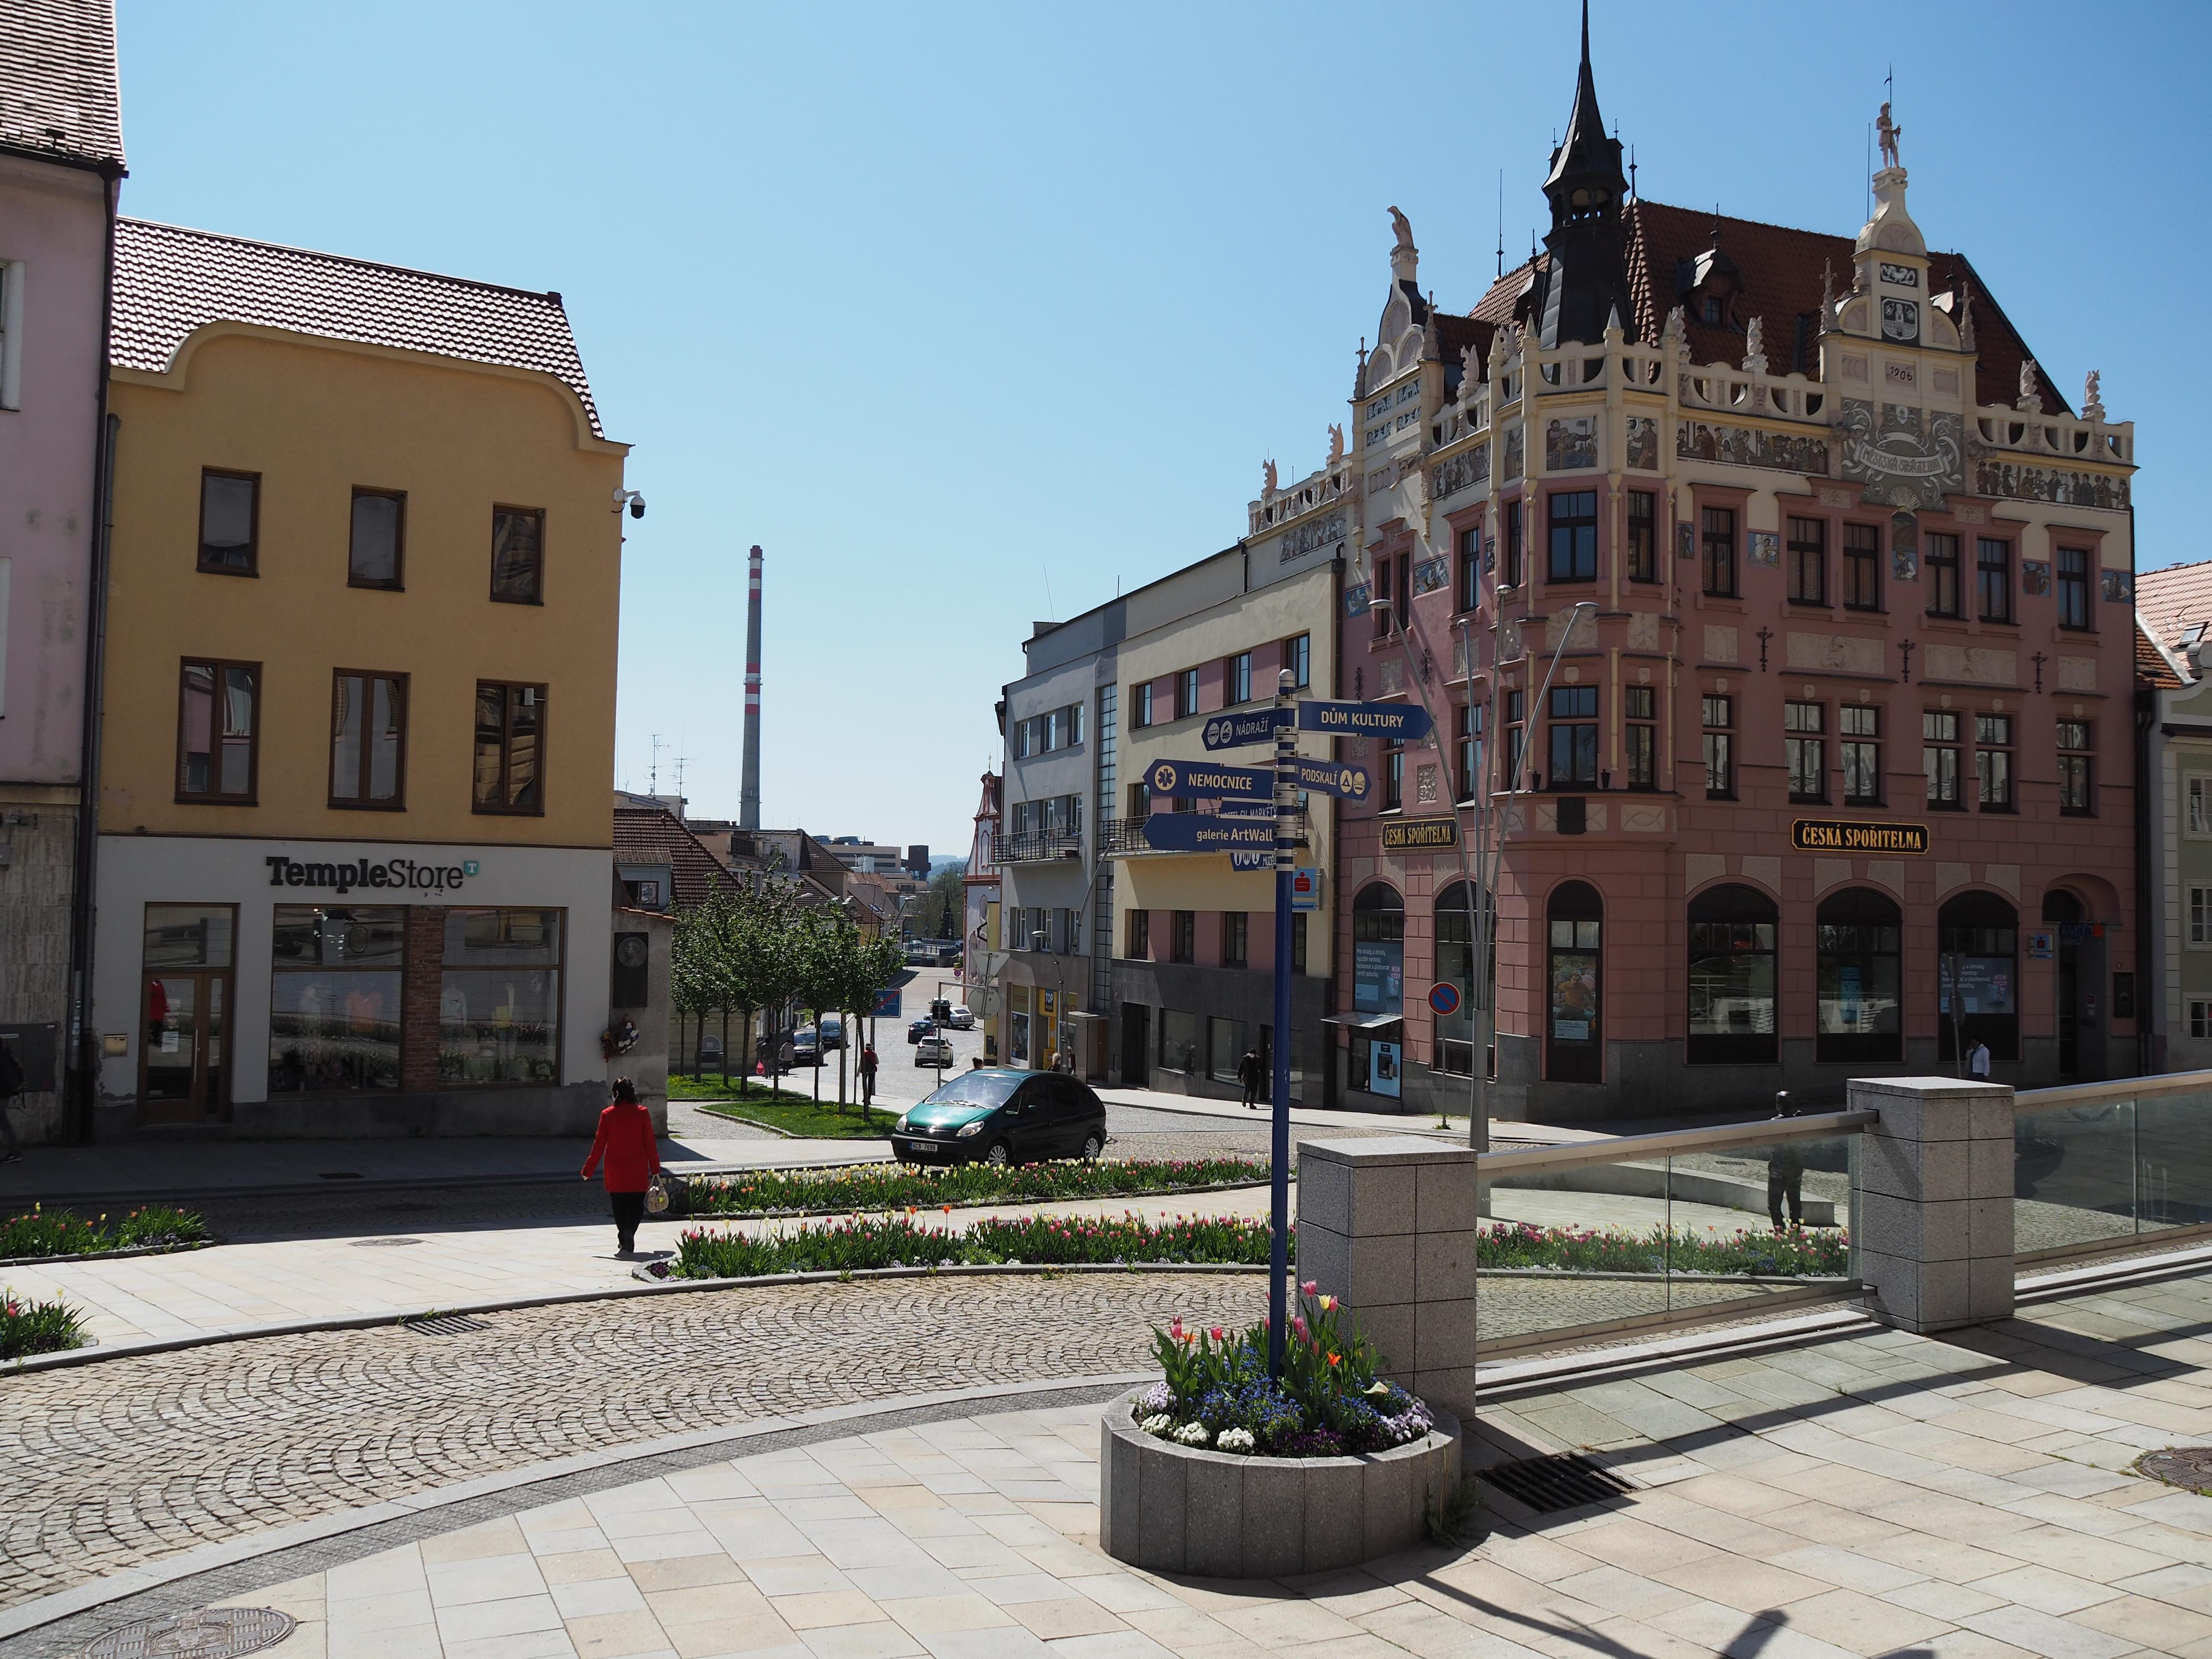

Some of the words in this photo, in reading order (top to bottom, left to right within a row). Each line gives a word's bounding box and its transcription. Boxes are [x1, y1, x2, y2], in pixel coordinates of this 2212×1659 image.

[1890, 366, 1912, 381] 1906
[1235, 717, 1269, 736] NÁDRAŽÍ
[1321, 707, 1348, 724] DŮM
[1352, 713, 1404, 728] KULTURY
[1188, 773, 1253, 790] NEMOCNICE
[1301, 768, 1337, 785] PODSKALÍ
[1196, 828, 1229, 841] galerie
[1230, 828, 1273, 842] ArtWall
[1385, 824, 1406, 845] ČESKÁ
[1407, 823, 1451, 844] SPOŘITELNA
[1802, 822, 1842, 846] ČESKÁ
[1845, 825, 1921, 849] SPOŘITELNA
[266, 857, 463, 894] TempleStore
[1045, 993, 1053, 1003] TOP
